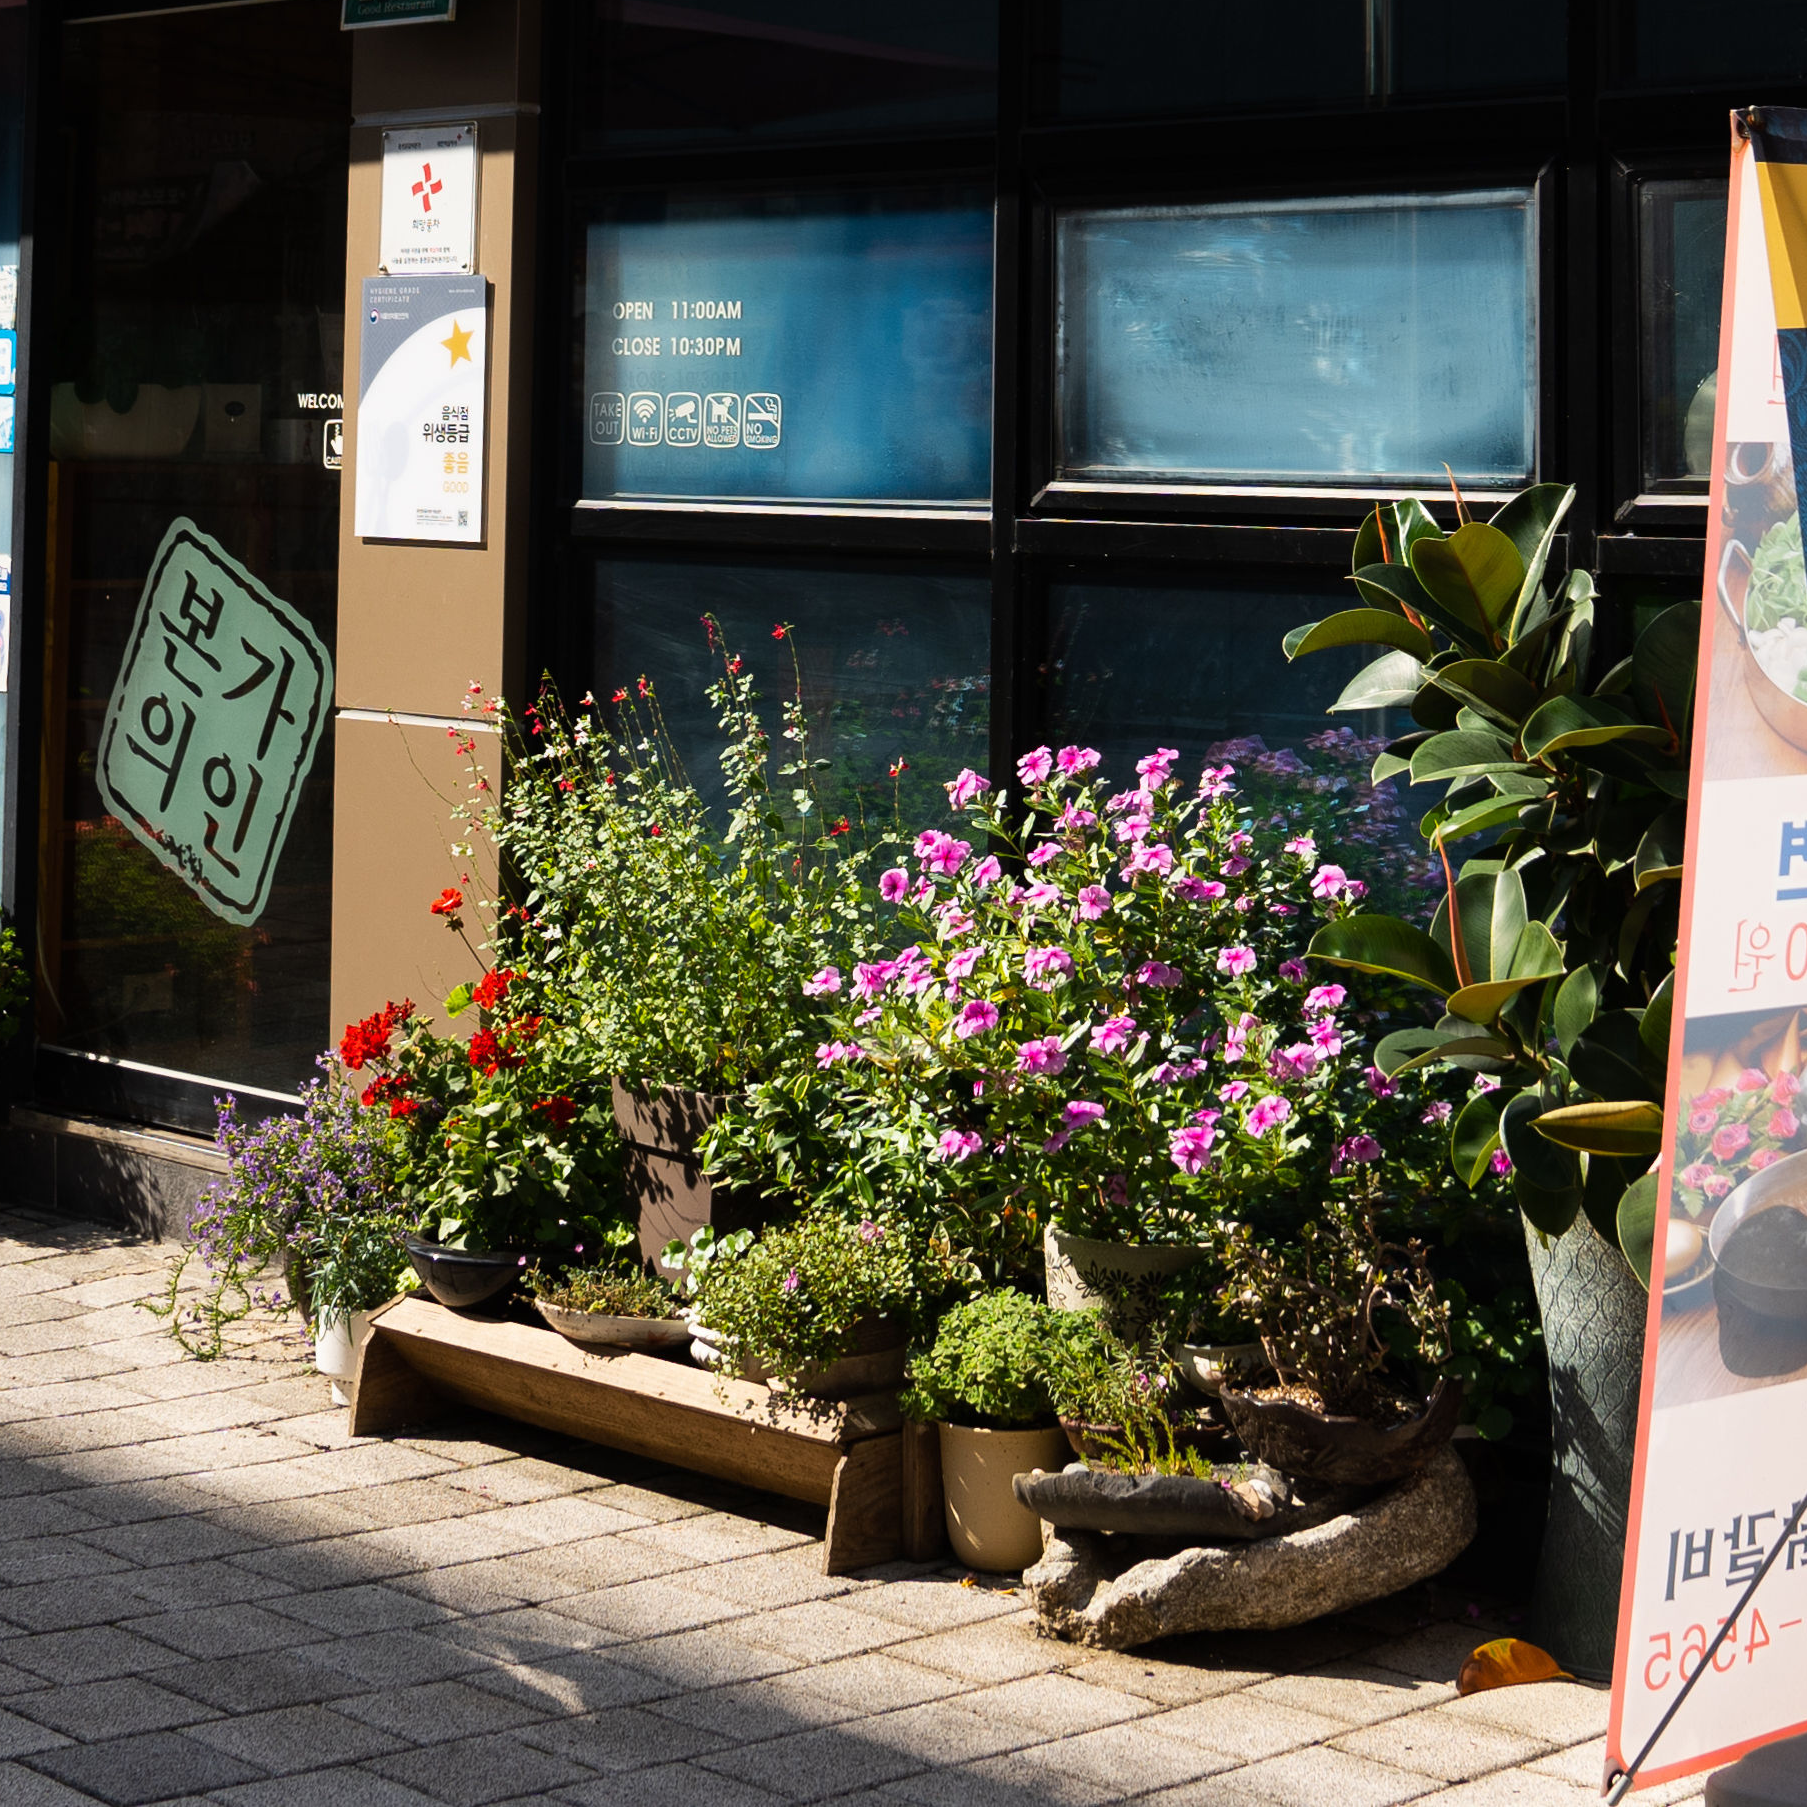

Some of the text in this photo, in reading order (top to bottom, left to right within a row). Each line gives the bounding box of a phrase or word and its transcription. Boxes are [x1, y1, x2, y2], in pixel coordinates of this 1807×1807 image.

[358, 0, 435, 15] Good Restaurant
[370, 287, 397, 295] HYGIENE
[370, 295, 410, 304] CERTIFICATE
[613, 301, 742, 320] OPEN 11:00AM
[612, 337, 742, 356] CLOSE 10:30PM
[442, 406, 469, 420] 음식점
[594, 403, 622, 417] TAKE
[423, 423, 470, 443] 위생등급
[596, 421, 619, 435] OUT
[669, 427, 697, 440] CCTV
[707, 425, 738, 435] NO PETS
[747, 423, 762, 435] NO
[706, 434, 738, 443] ALLOWED
[746, 435, 777, 444] SMOKING
[443, 452, 468, 474] 좋음
[443, 482, 469, 493] GOOD
